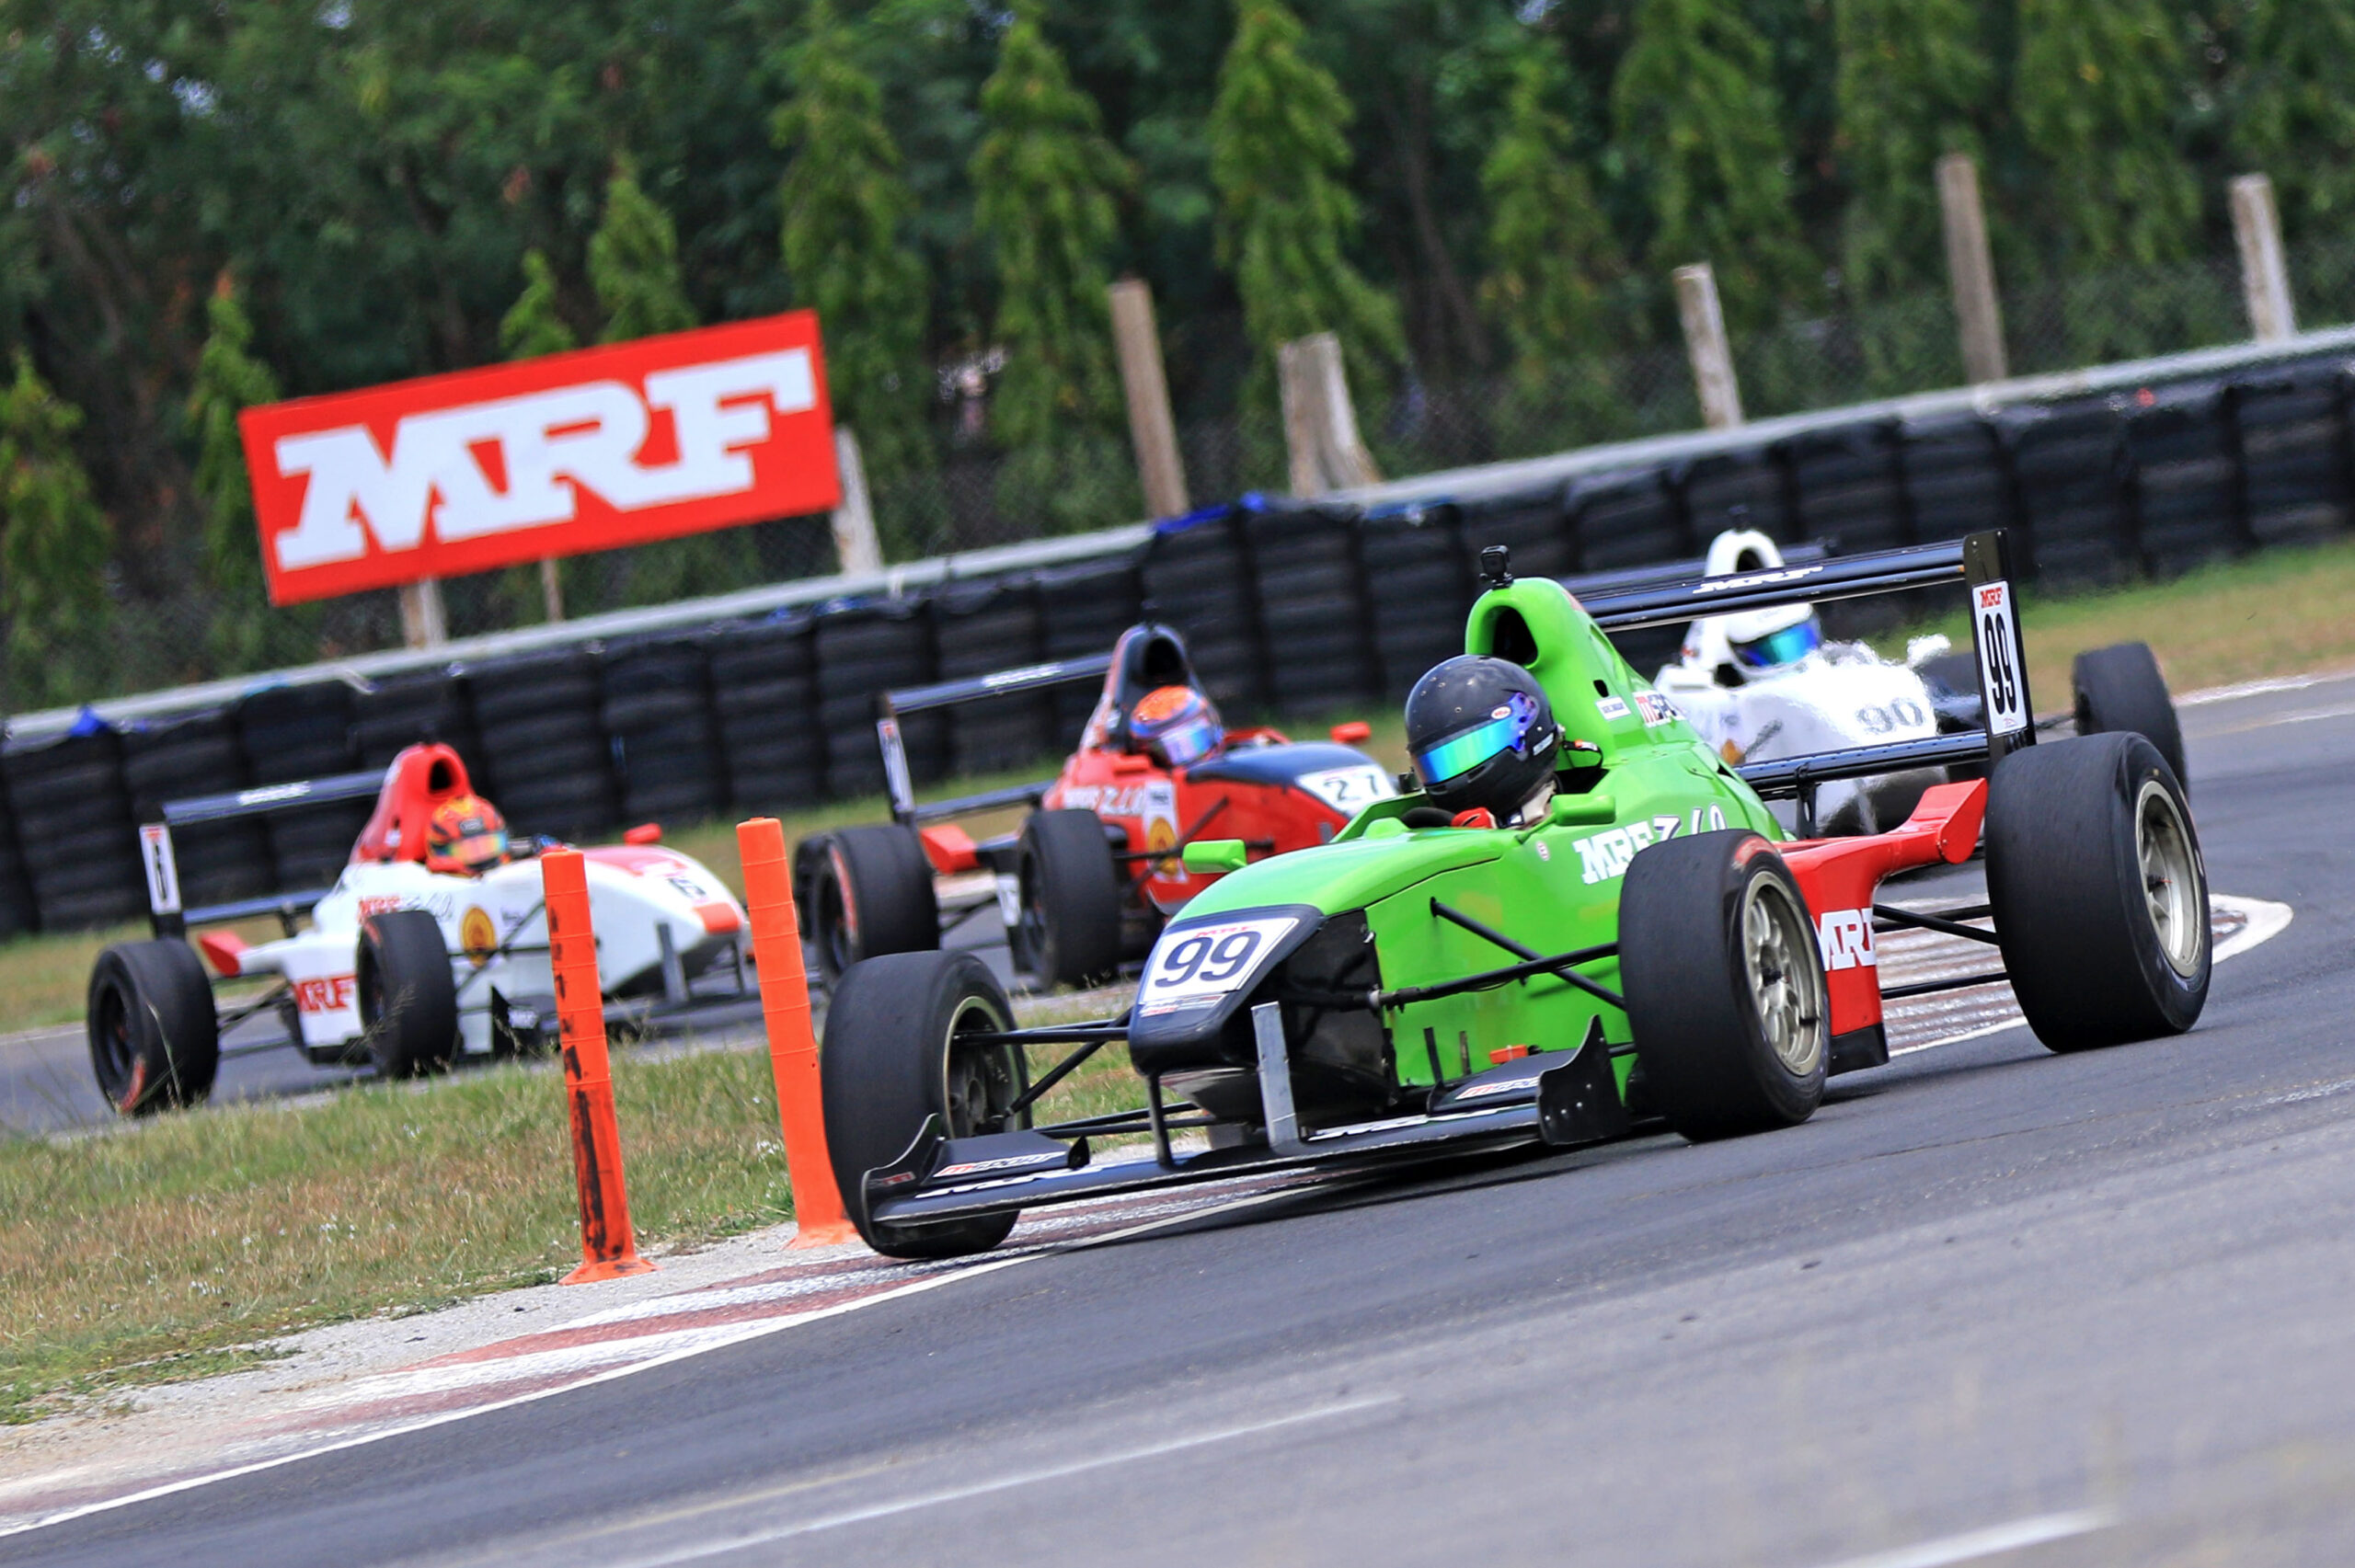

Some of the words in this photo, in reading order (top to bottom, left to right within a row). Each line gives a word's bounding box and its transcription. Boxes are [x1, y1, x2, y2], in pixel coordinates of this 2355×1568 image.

[275, 346, 817, 572] MRF
[1980, 587, 2003, 609] MRF
[1984, 612, 2017, 715] 99
[1855, 697, 1924, 735] 90
[1323, 774, 1379, 801] 27
[1572, 820, 1653, 885] MRF
[1155, 931, 1261, 988] 99
[293, 974, 357, 1013] MRF
